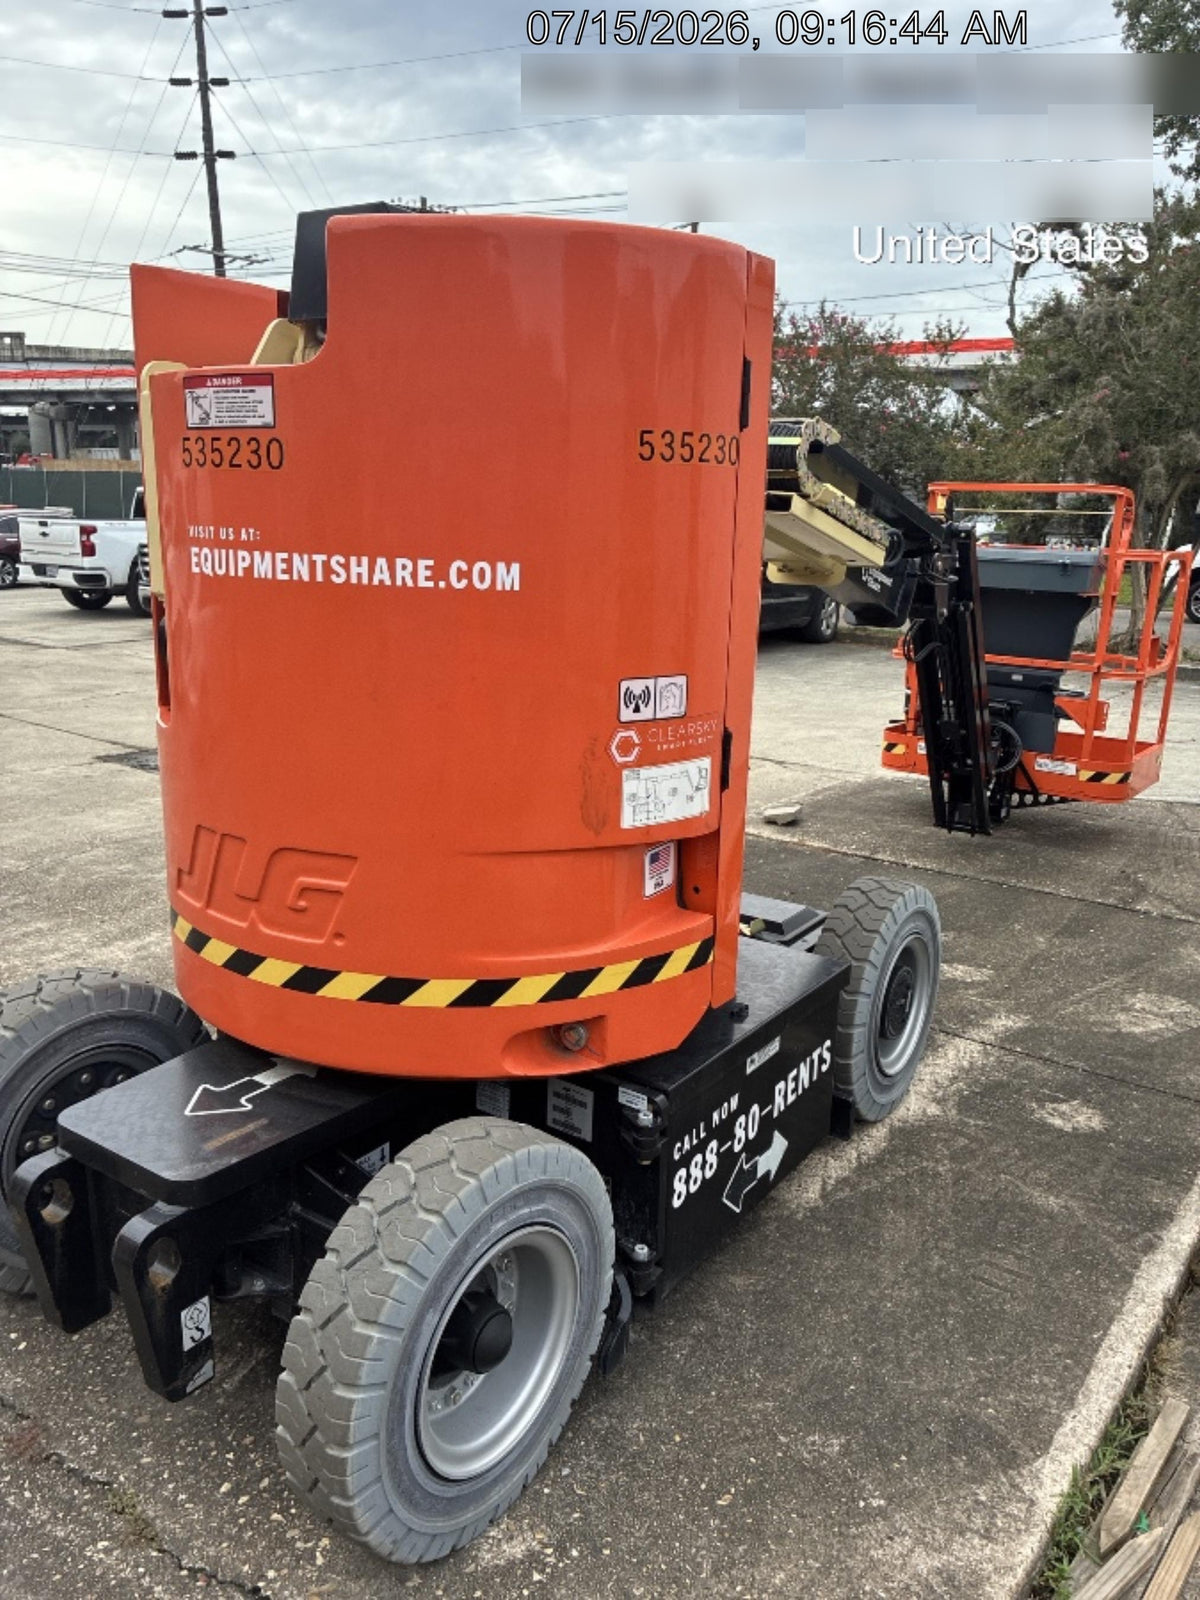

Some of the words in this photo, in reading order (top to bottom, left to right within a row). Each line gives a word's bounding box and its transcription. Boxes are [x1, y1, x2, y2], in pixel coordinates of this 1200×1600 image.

[181, 436, 284, 470] 535230
[638, 429, 740, 466] 535230
[188, 525, 215, 539] VISIT
[220, 527, 235, 541] US
[240, 528, 261, 541] AT:
[190, 546, 521, 592] EQUIPMENTSHARE.COM
[646, 719, 719, 743] CLEARSKY
[177, 824, 359, 945] JLG
[671, 1039, 833, 1210] 888-80-RENTS
[673, 1121, 707, 1161] CALL
[712, 1092, 740, 1129] NOW
